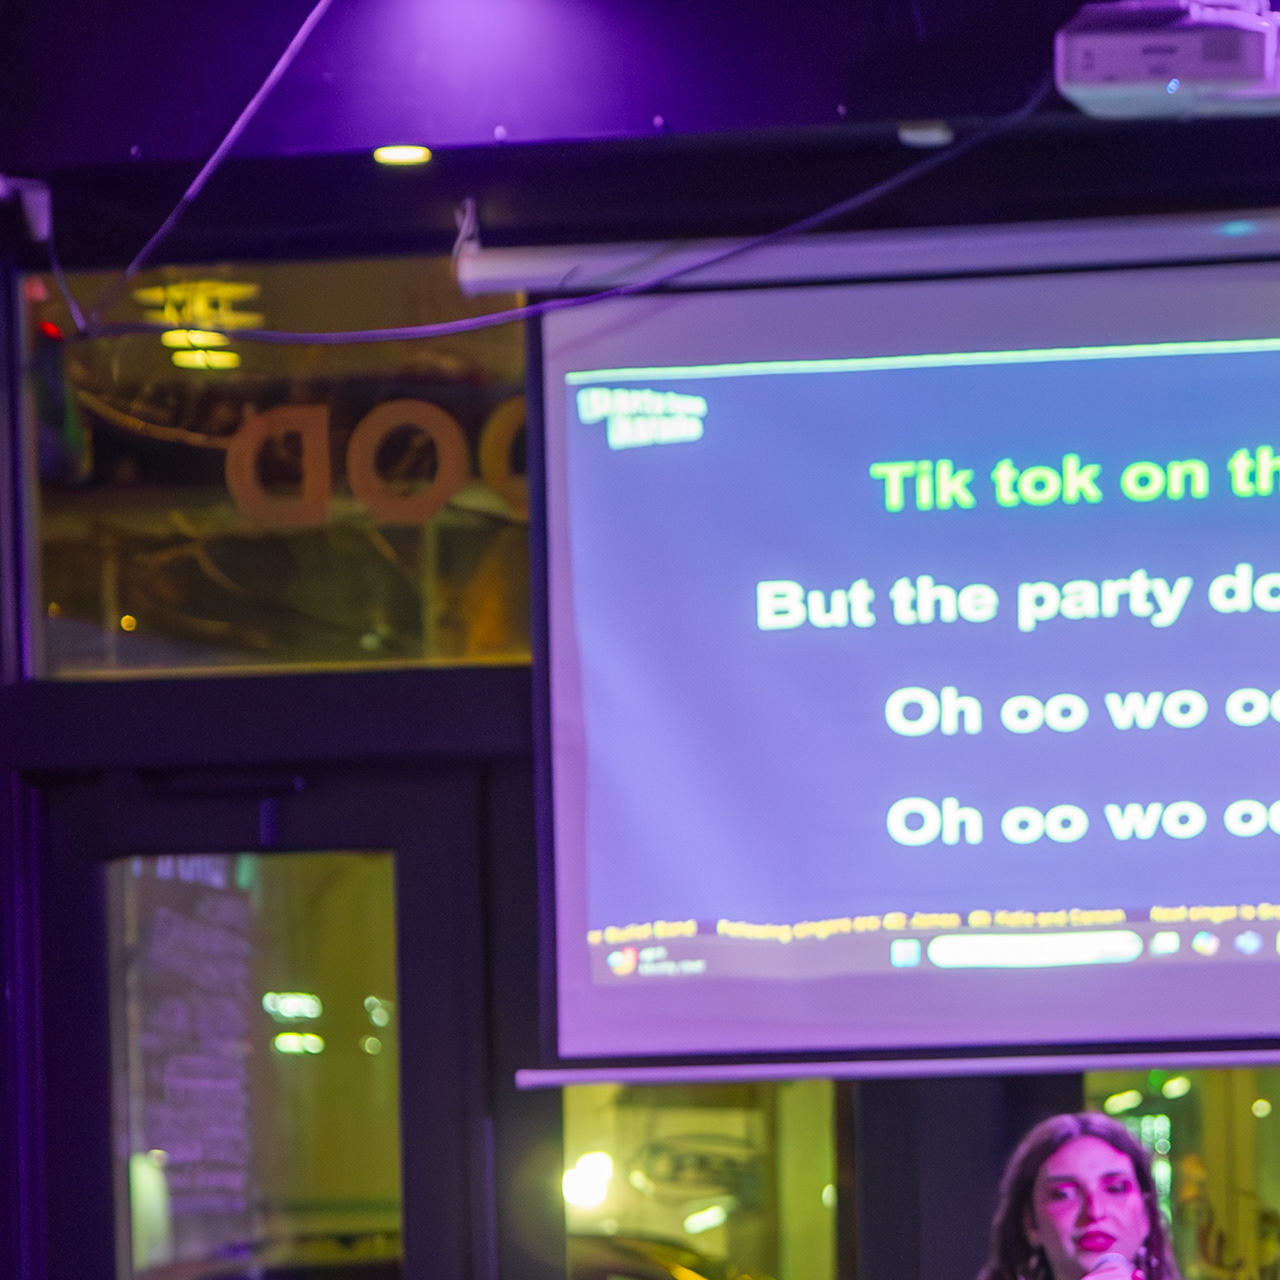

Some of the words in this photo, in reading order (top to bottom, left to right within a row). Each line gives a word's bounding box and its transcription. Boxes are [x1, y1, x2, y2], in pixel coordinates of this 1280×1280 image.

[868, 457, 977, 514] Tik
[989, 450, 1104, 509] tok
[1118, 457, 1211, 504] on
[755, 577, 877, 632] But
[888, 573, 1000, 627] the
[1016, 567, 1194, 634] party
[883, 685, 984, 738] Oh
[999, 692, 1091, 735] oo
[1103, 688, 1210, 731] wo
[885, 795, 985, 848] Oh
[999, 803, 1091, 846] oo
[1103, 799, 1208, 842] wo
